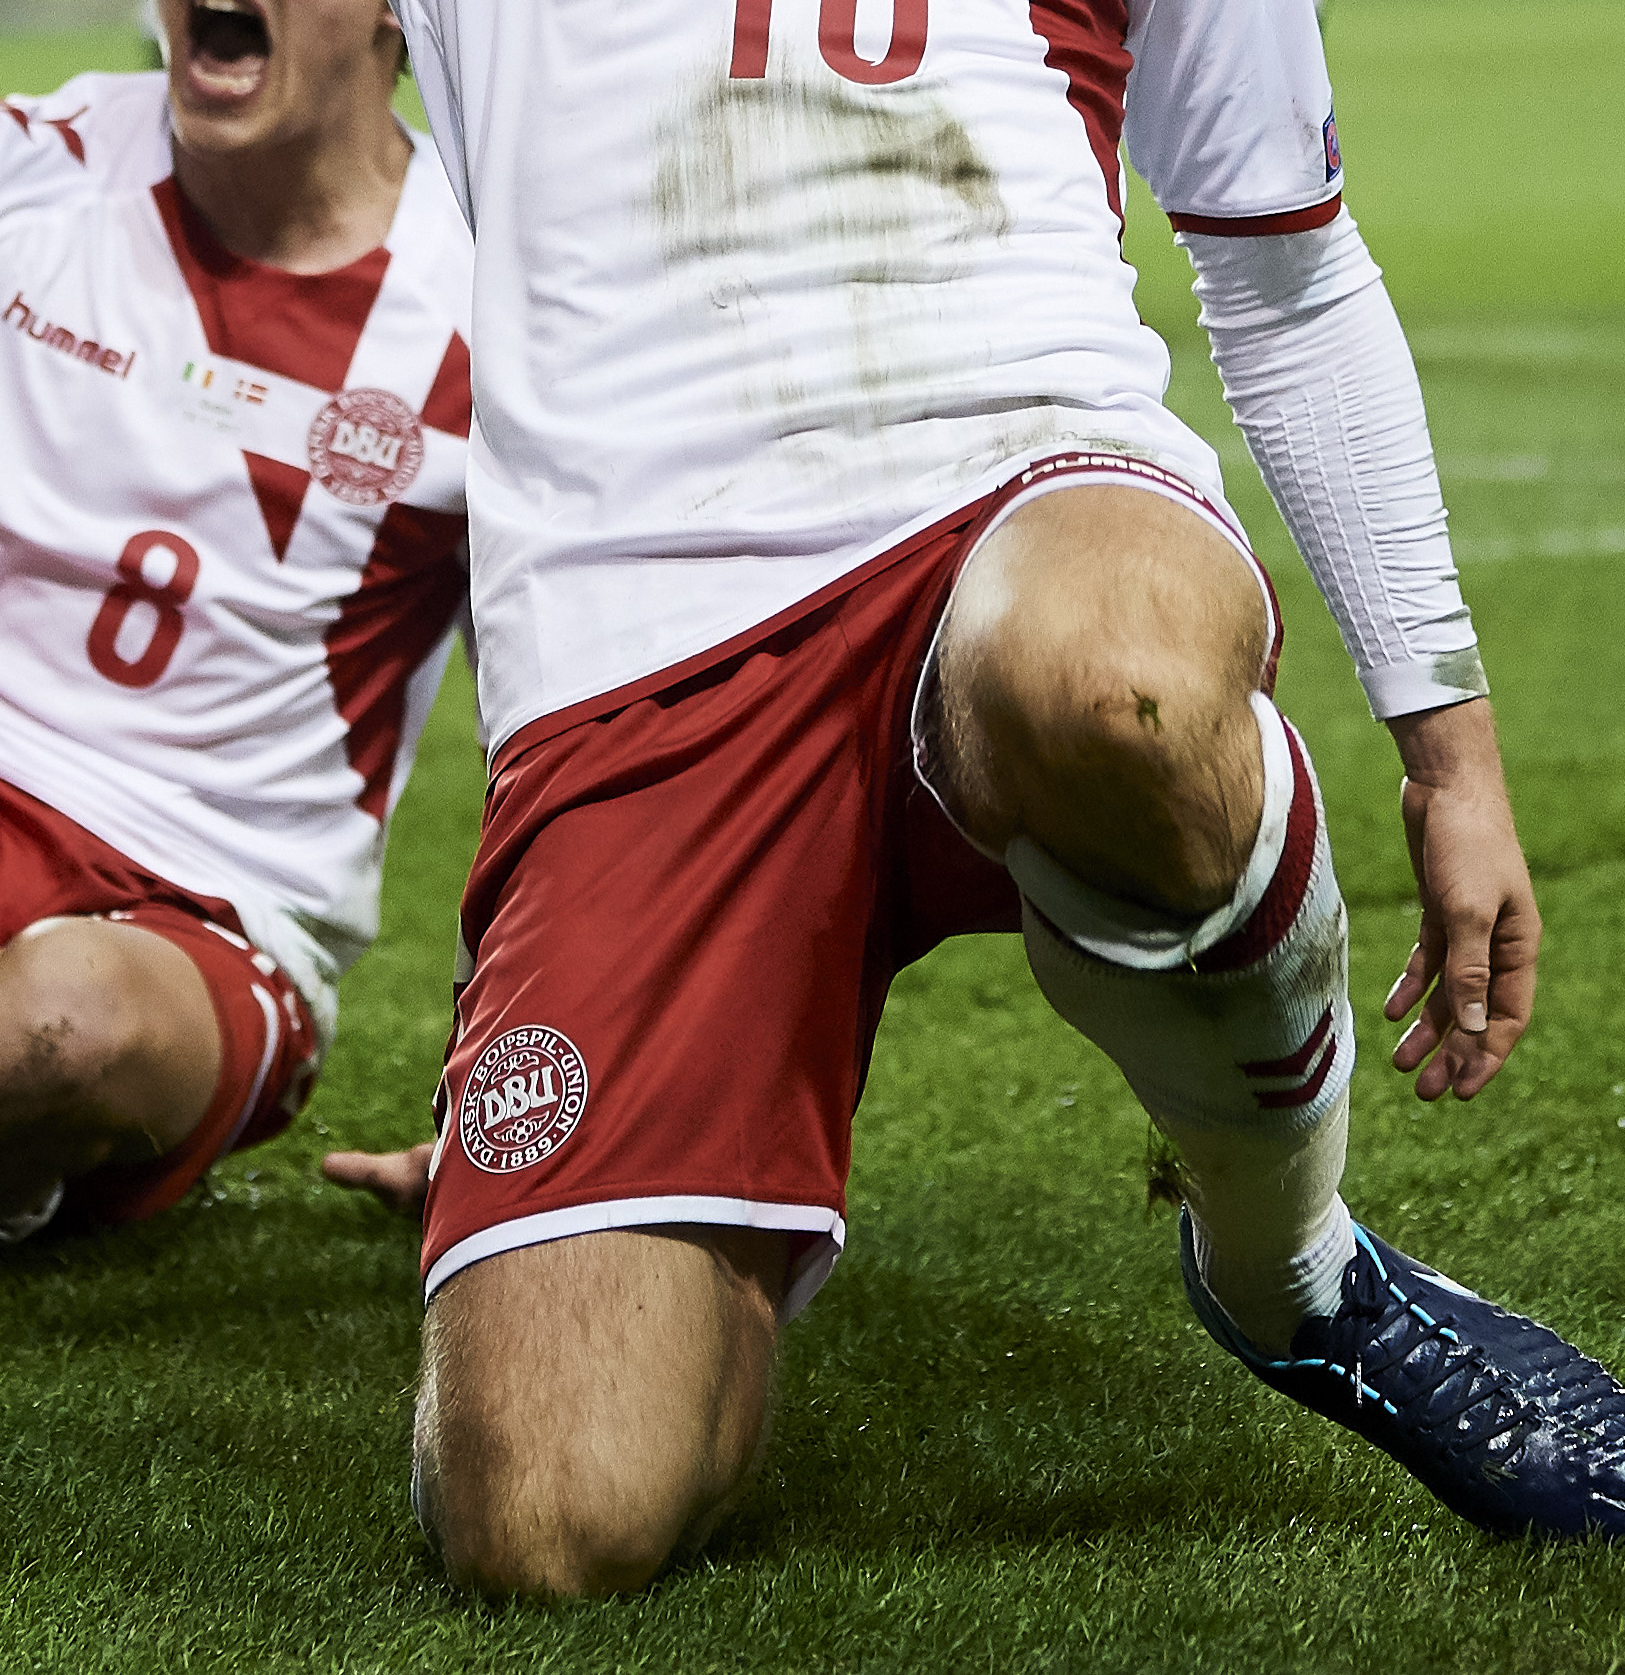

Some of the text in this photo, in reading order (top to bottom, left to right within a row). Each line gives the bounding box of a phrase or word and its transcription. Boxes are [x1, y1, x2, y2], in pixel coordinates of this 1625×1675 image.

[2, 291, 136, 380] hummel
[328, 420, 403, 470] DBU
[86, 530, 200, 690] 8
[464, 1091, 494, 1165] DANSK
[482, 1065, 559, 1130] DBU
[501, 1137, 553, 1168] 1889
